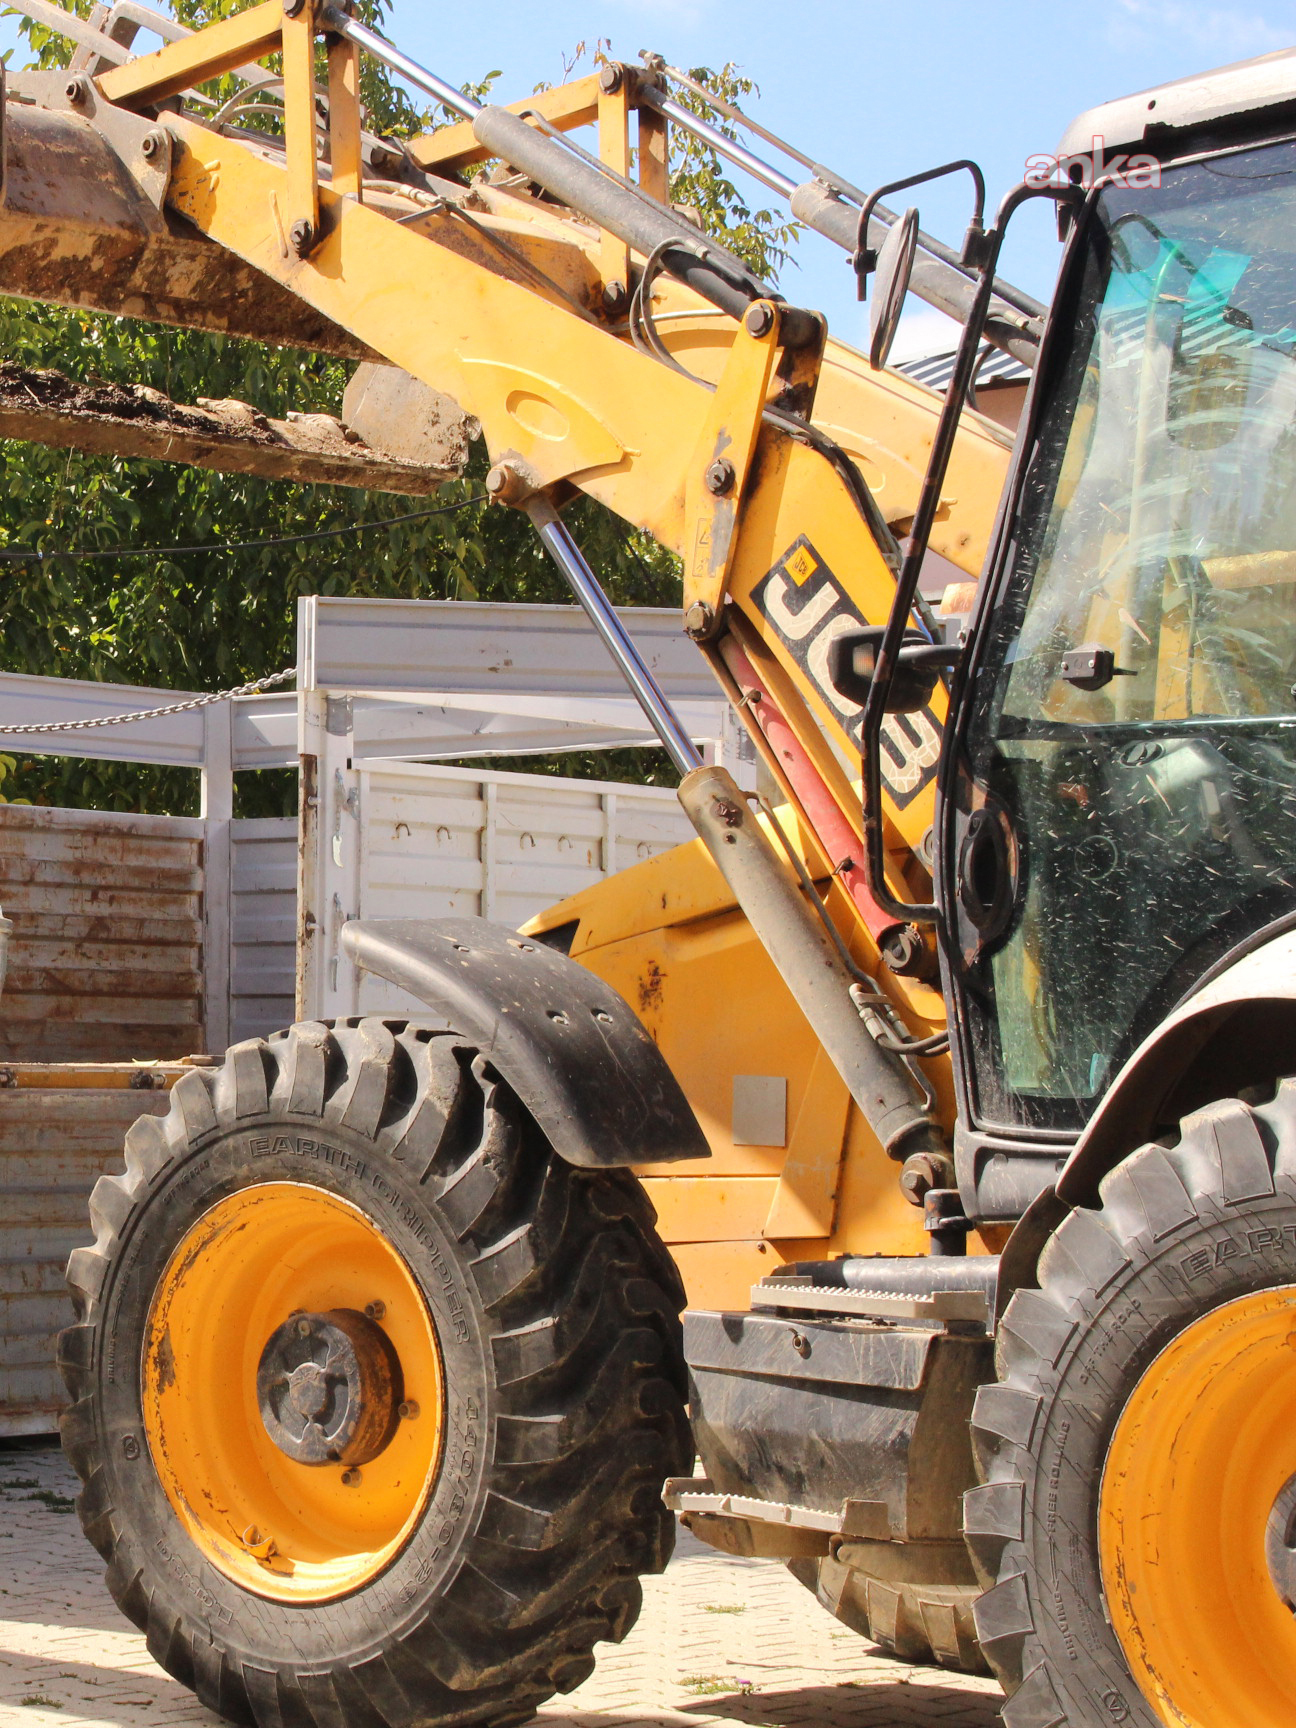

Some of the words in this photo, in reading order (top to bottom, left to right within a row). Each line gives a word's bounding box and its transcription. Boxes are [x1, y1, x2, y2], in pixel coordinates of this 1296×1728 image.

[249, 1136, 365, 1180] EARTH
[372, 1173, 470, 1344] GRIPPER
[1048, 1420, 1070, 1489] ROLLING
[1046, 1492, 1057, 1532] FREE
[1052, 1591, 1078, 1661] DRIVING
